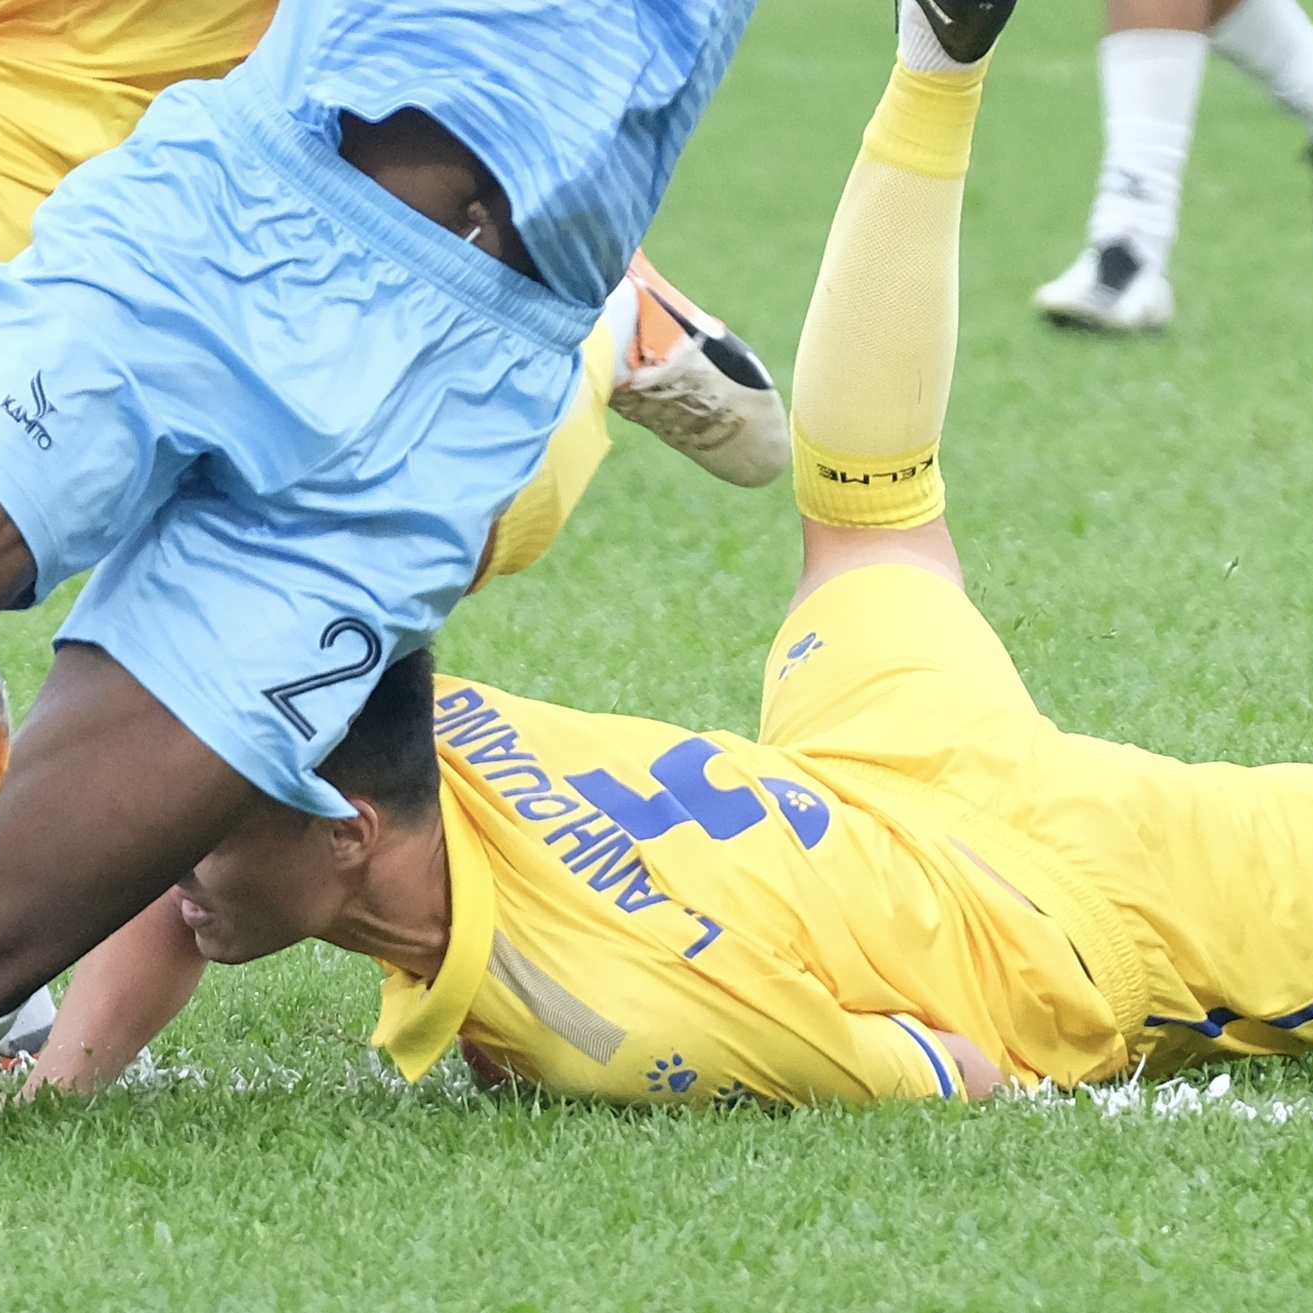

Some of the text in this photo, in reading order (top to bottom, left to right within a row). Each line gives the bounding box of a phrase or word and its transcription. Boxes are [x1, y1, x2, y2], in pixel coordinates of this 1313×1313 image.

[0, 392, 54, 452] KAMITO
[815, 453, 935, 487] KELME
[260, 615, 383, 744] 2
